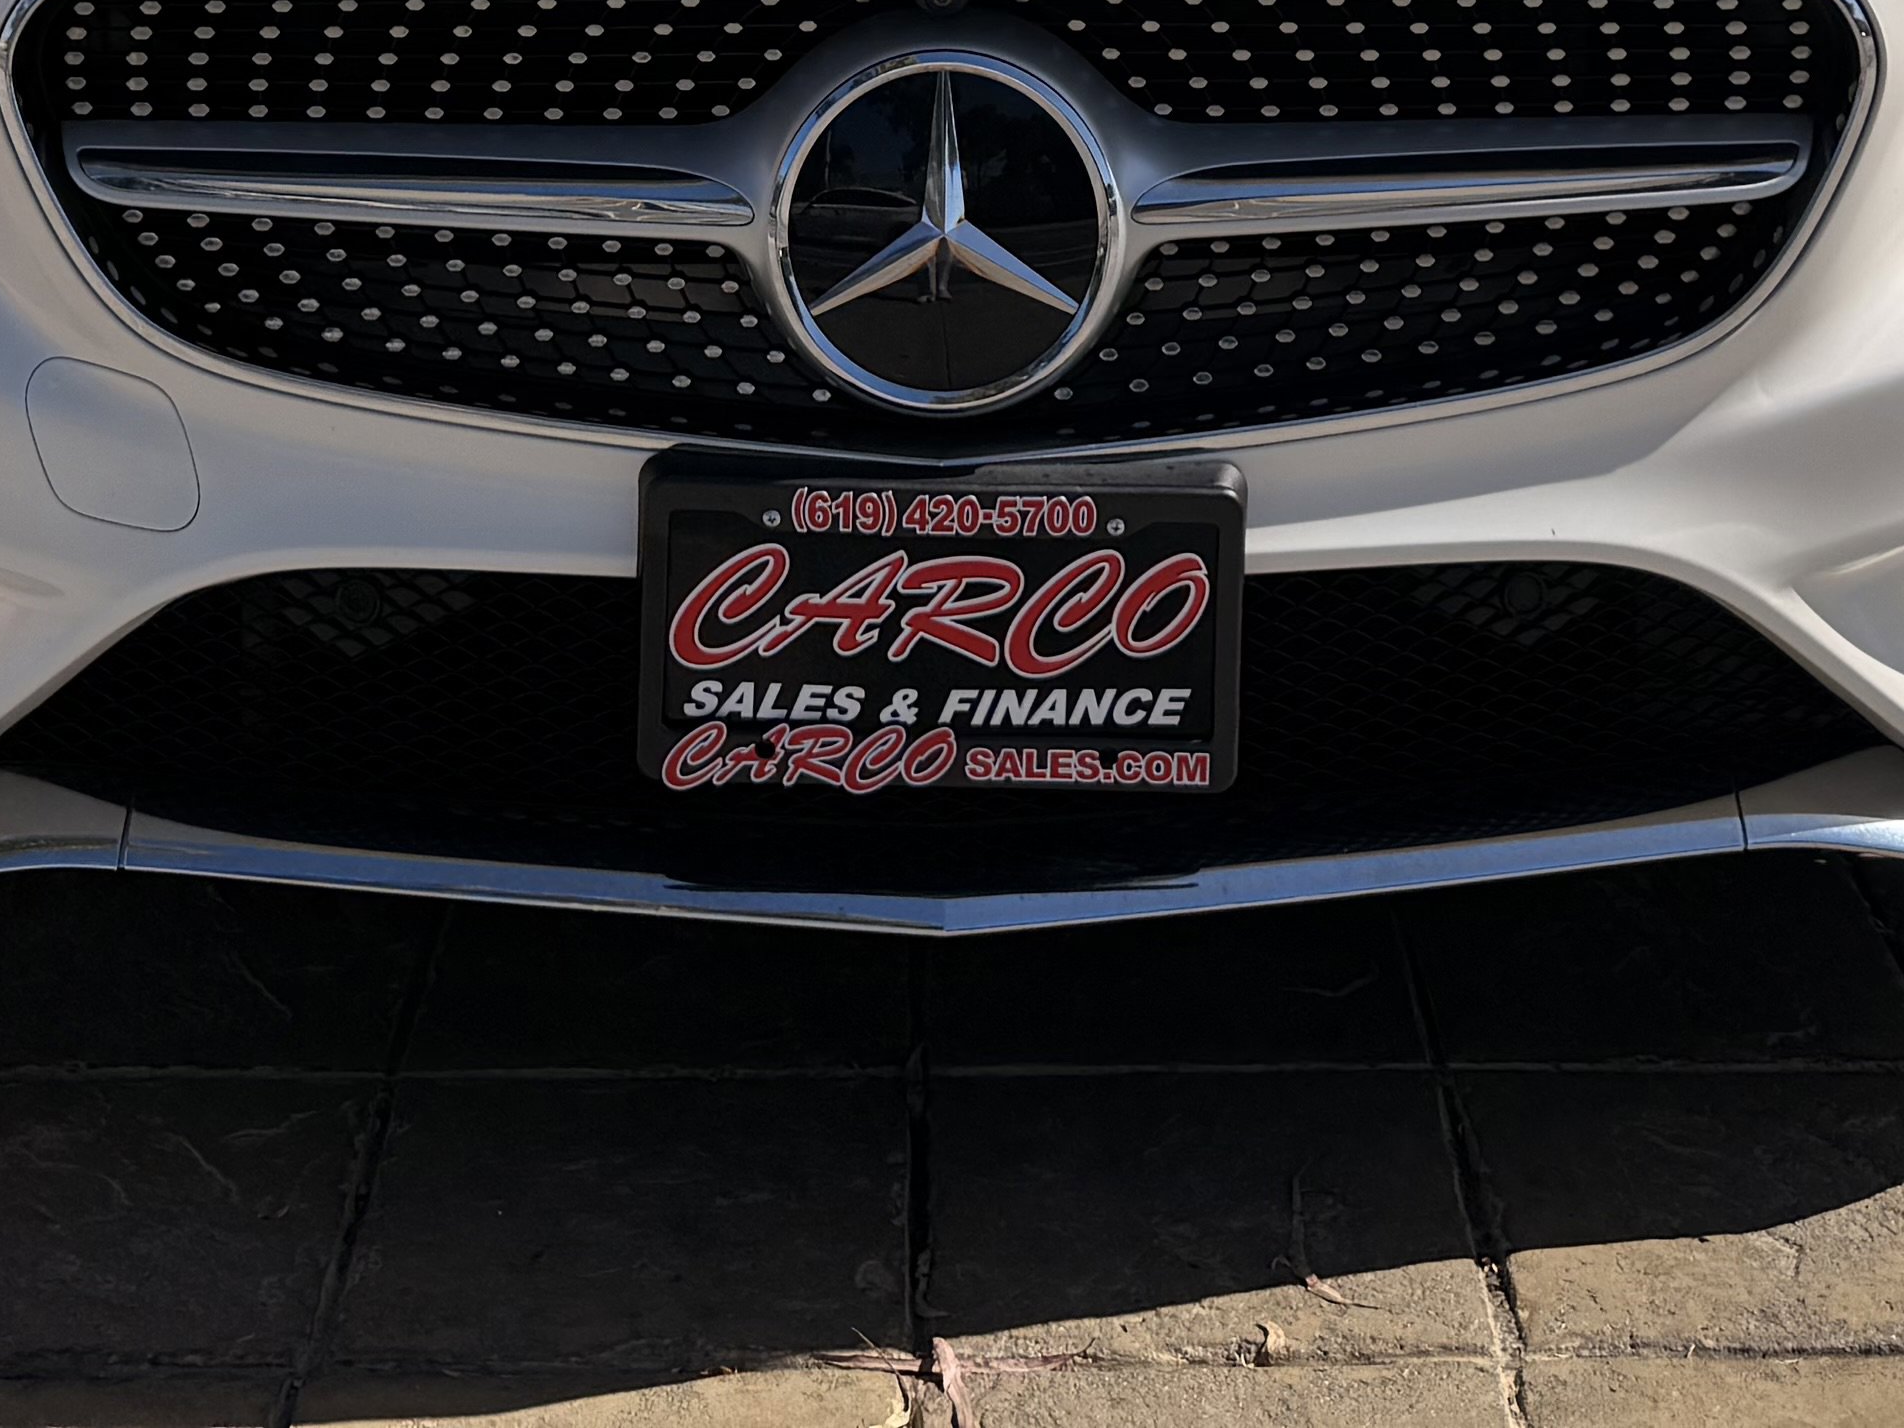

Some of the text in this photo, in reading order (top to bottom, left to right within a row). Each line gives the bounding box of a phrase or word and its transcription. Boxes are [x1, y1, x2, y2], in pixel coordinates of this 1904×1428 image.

[791, 487, 1098, 537] (619) 420-5700
[669, 543, 1210, 679] CARCO
[683, 680, 1192, 727] SALES & FINANCE
[661, 722, 1211, 794] CARCO SALES.COM
